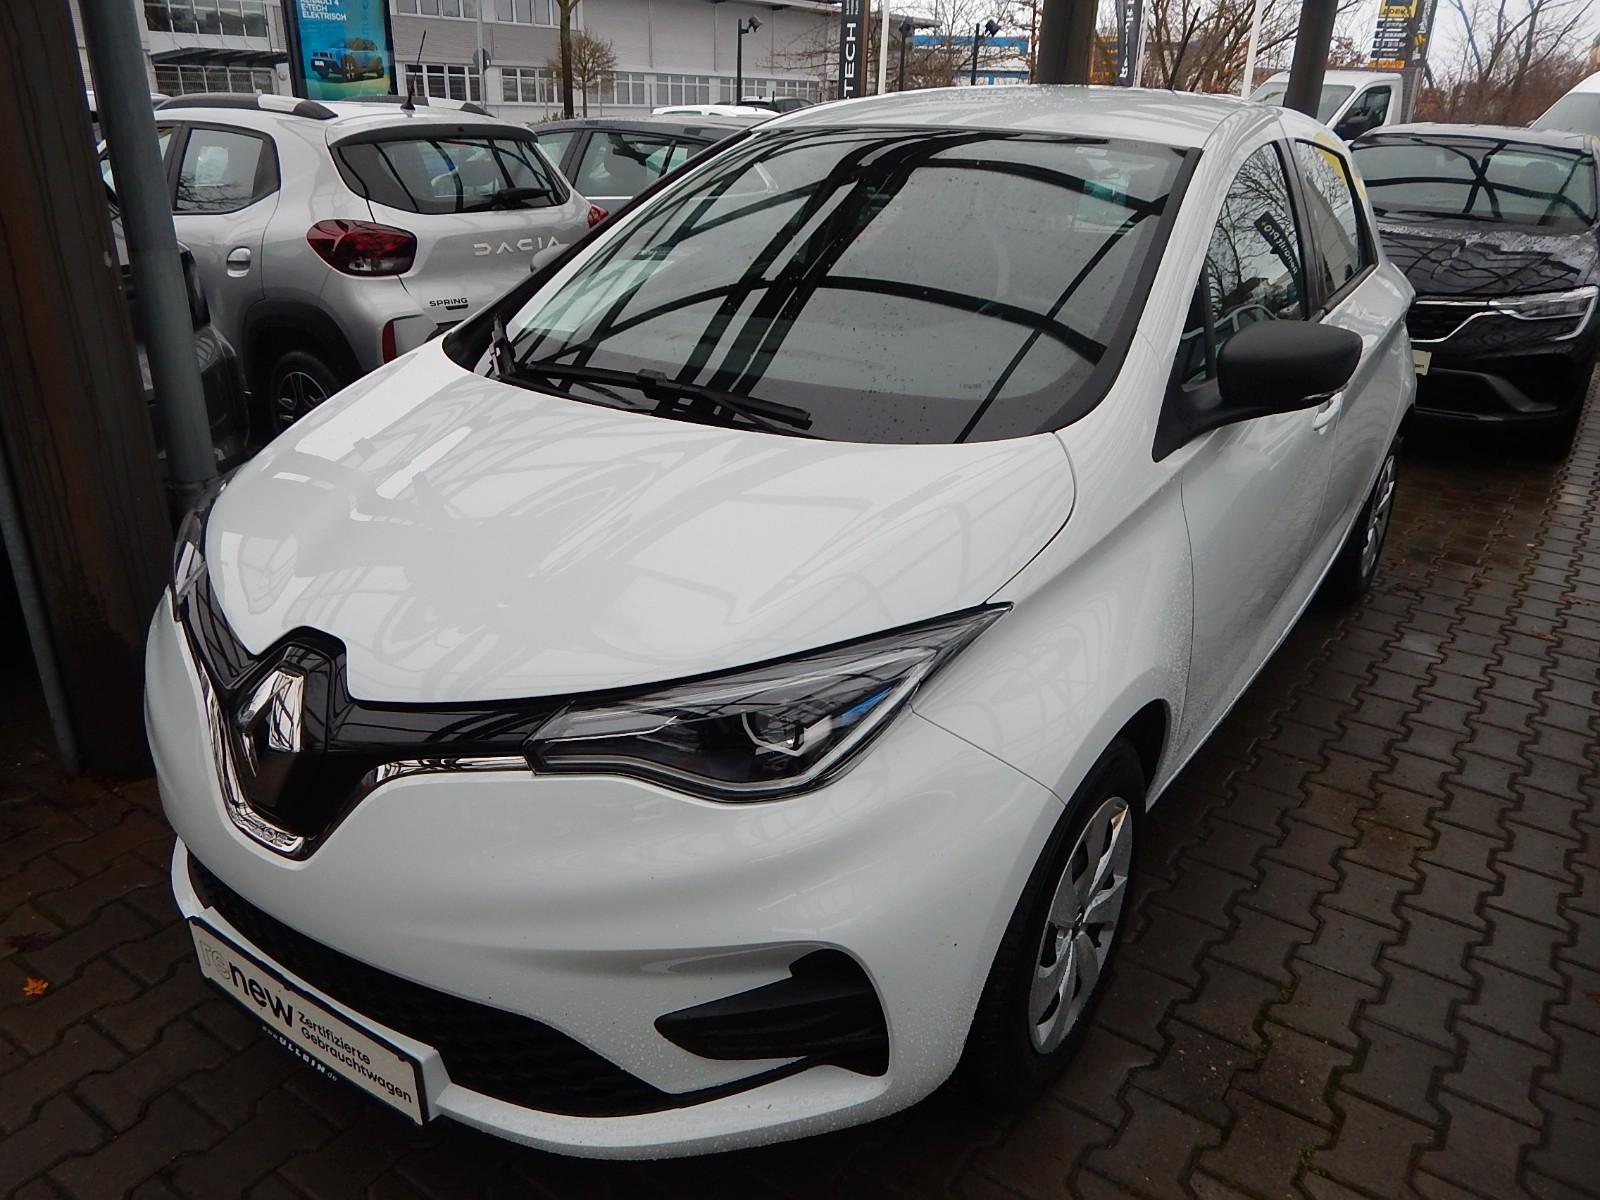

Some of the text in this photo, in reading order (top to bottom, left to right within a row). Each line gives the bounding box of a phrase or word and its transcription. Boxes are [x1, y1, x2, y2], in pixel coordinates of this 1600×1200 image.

[302, 11, 347, 21] ELEKTRISCH
[473, 236, 562, 256] DACIA
[429, 297, 468, 307] SPRING
[199, 941, 293, 1028] renew
[298, 1011, 370, 1065] Zertifizierte
[301, 1027, 412, 1103] Gebrauchtwagen
